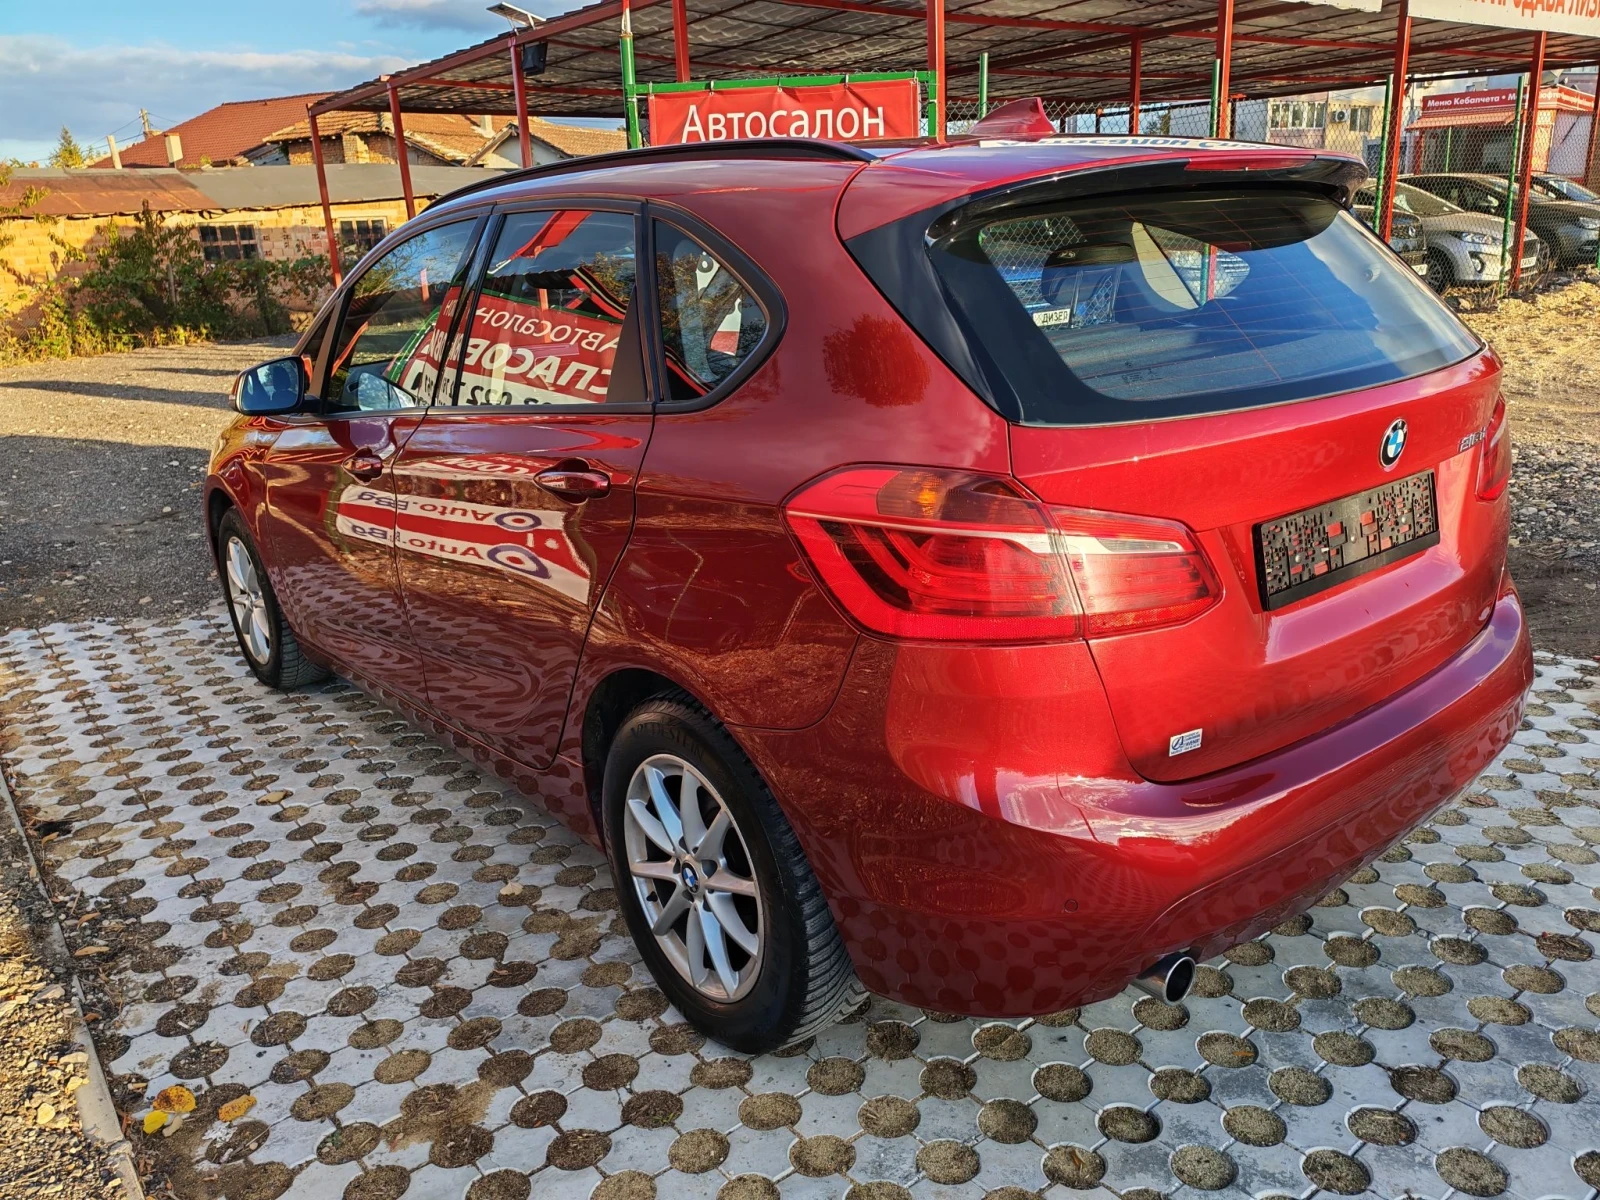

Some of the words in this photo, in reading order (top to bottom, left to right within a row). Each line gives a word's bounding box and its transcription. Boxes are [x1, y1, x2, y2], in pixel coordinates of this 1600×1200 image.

[1568, 0, 1600, 18] ЛИЗ
[1427, 98, 1452, 108] Меню
[1453, 95, 1500, 105] Кебапчета
[681, 104, 885, 144] Автосалон
